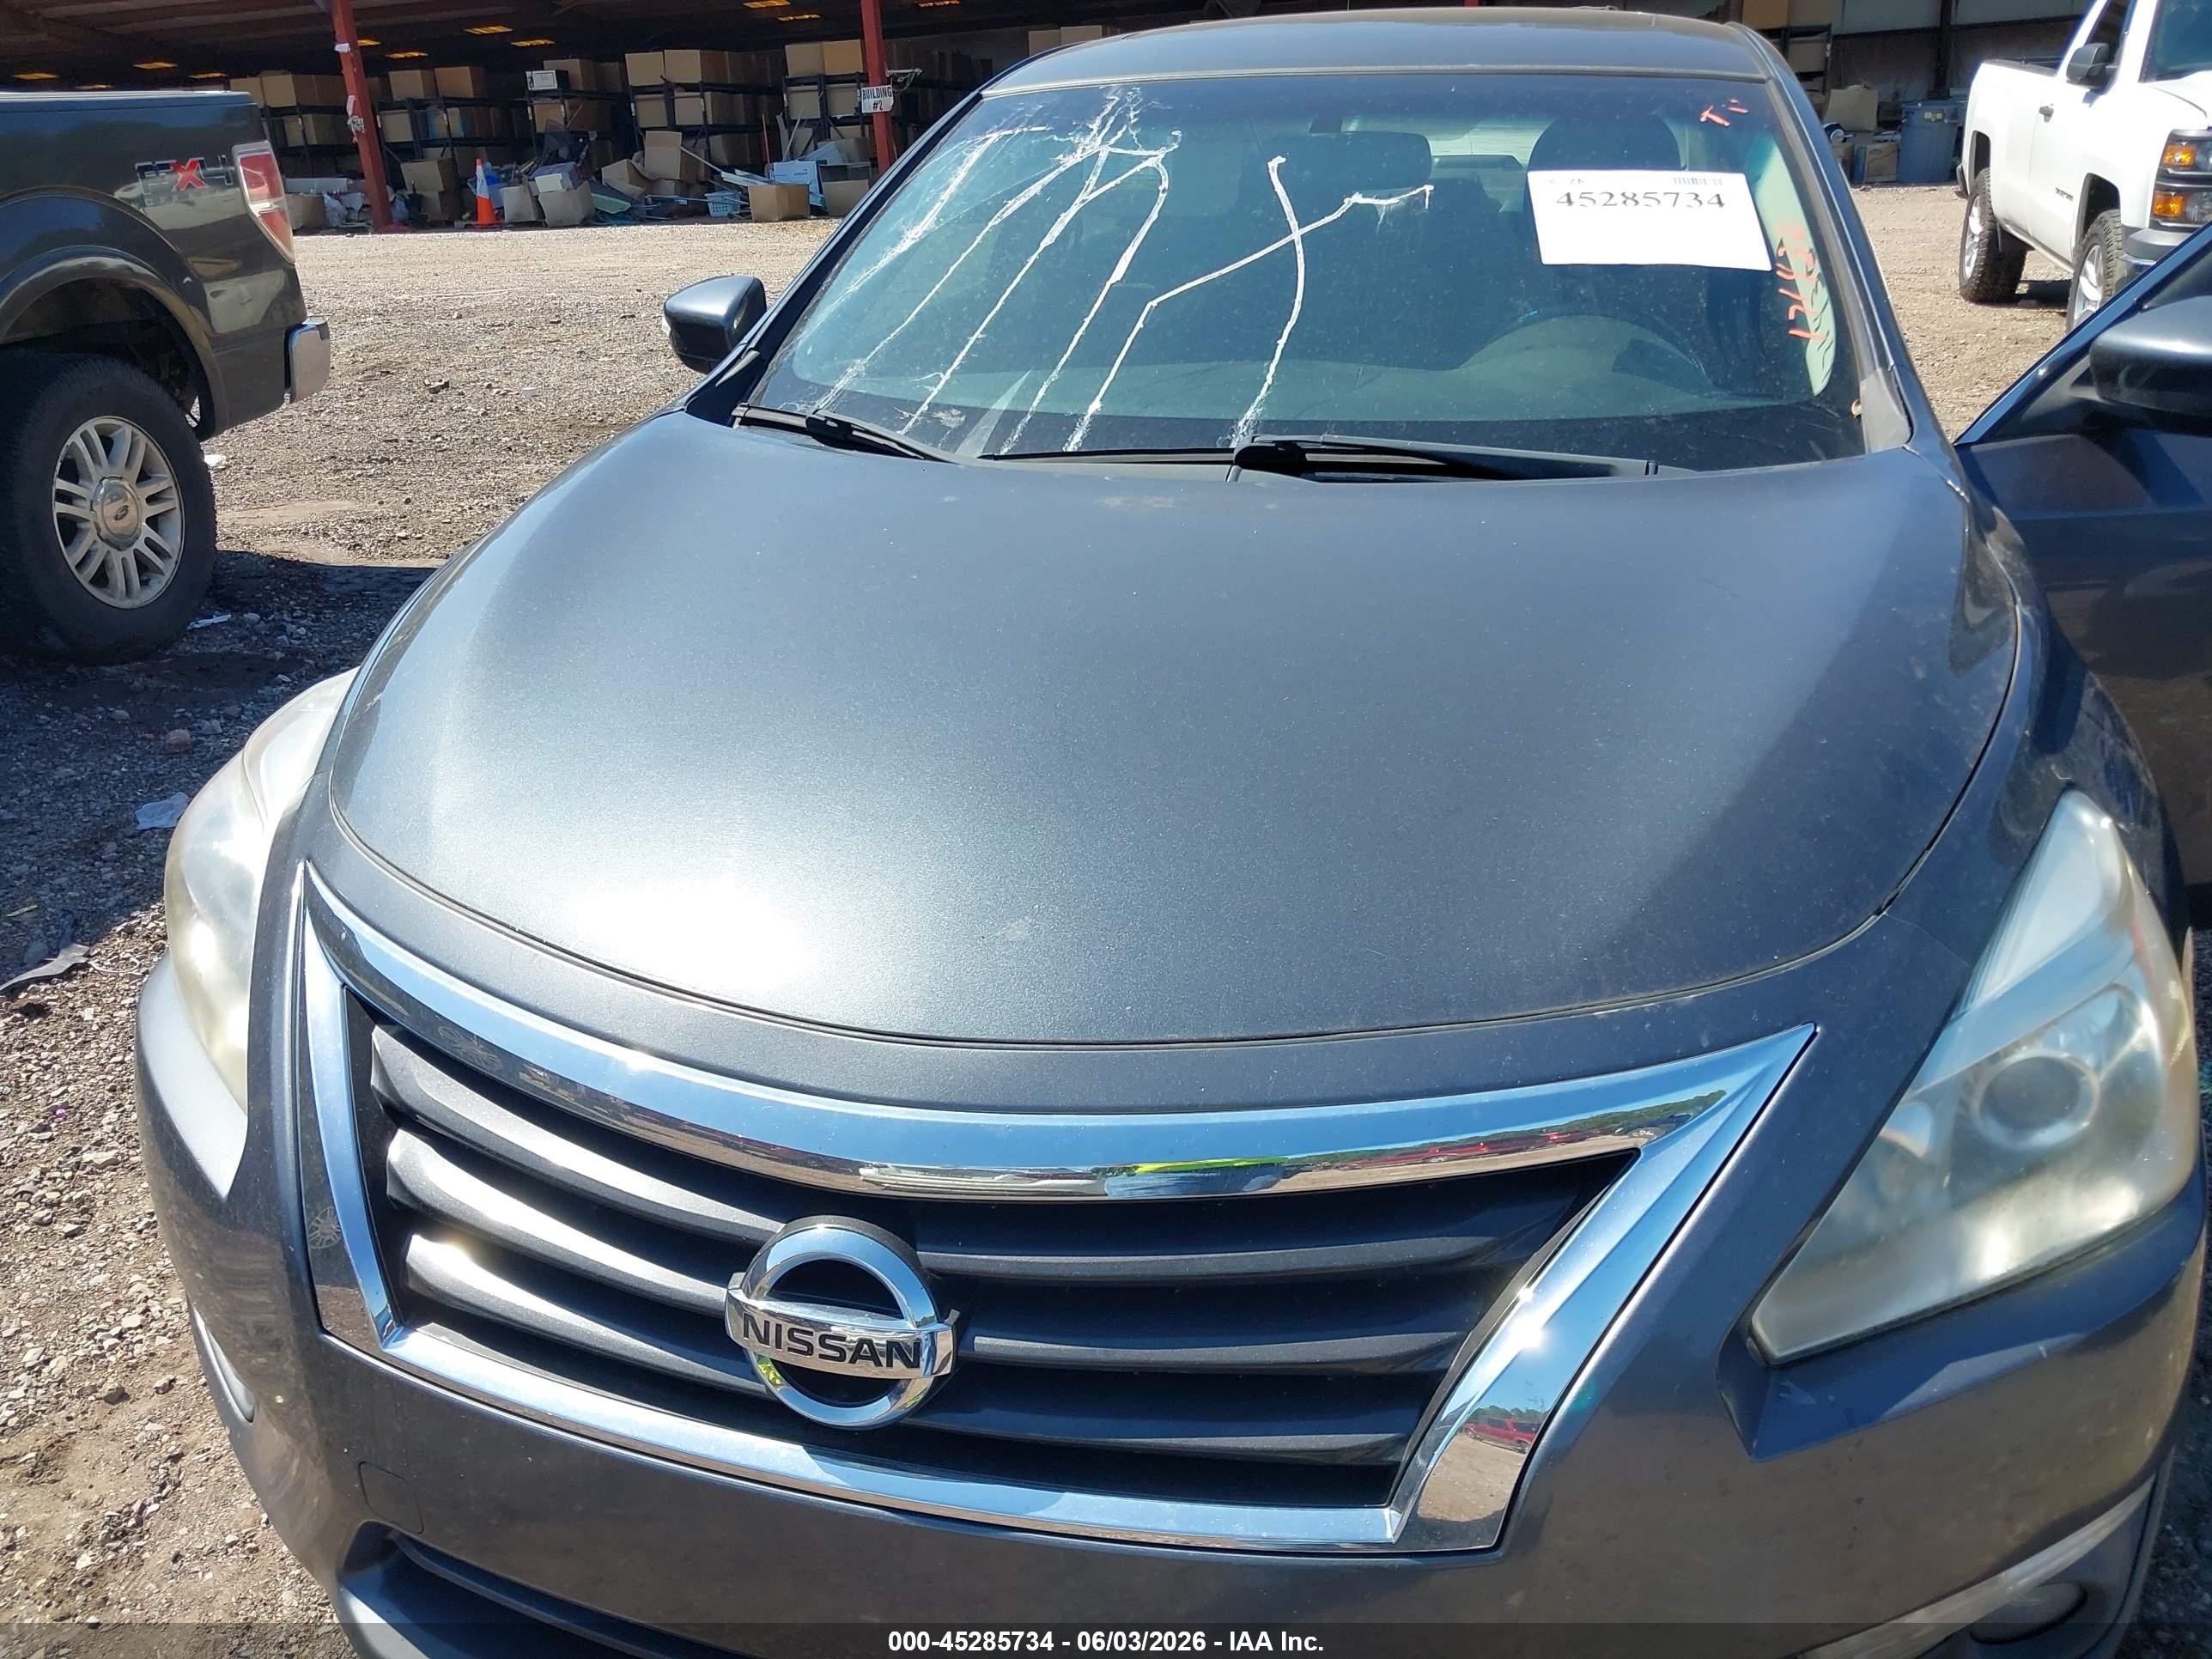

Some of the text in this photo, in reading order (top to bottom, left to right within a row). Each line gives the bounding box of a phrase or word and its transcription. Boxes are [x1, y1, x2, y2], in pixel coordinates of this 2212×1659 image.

[862, 86, 892, 100] BUILDING
[872, 100, 883, 111] #2
[135, 155, 235, 192] FX4
[1555, 191, 1726, 209] 45285734
[743, 1313, 921, 1370] NISSAN
